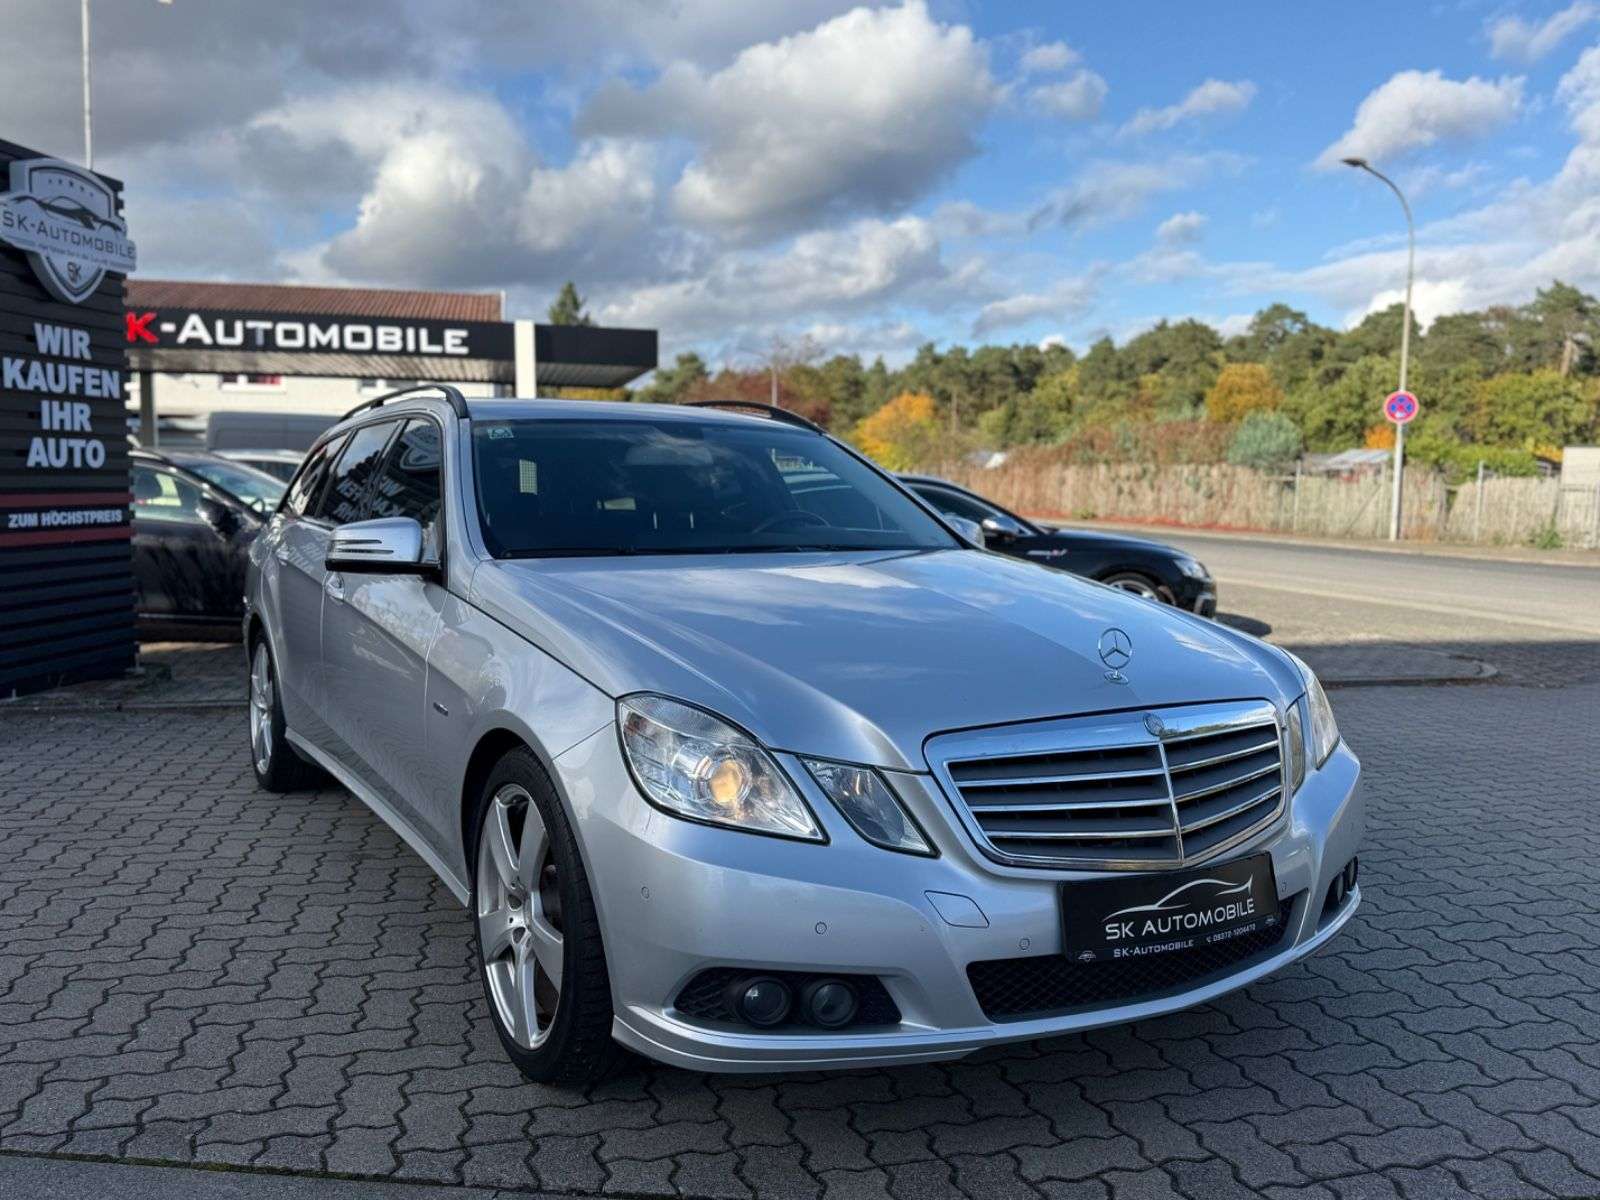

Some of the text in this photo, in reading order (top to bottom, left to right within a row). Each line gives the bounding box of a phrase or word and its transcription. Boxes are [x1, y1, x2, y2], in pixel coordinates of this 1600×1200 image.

[34, 322, 93, 361] WIR
[2, 356, 121, 400] KAUFEN
[40, 400, 93, 432] IHR
[27, 437, 106, 469] AUTO
[8, 512, 39, 529] ZUM
[1105, 897, 1255, 940] SK AUTOMOBILE
[1113, 939, 1195, 958] SK-AUTOMOBILE
